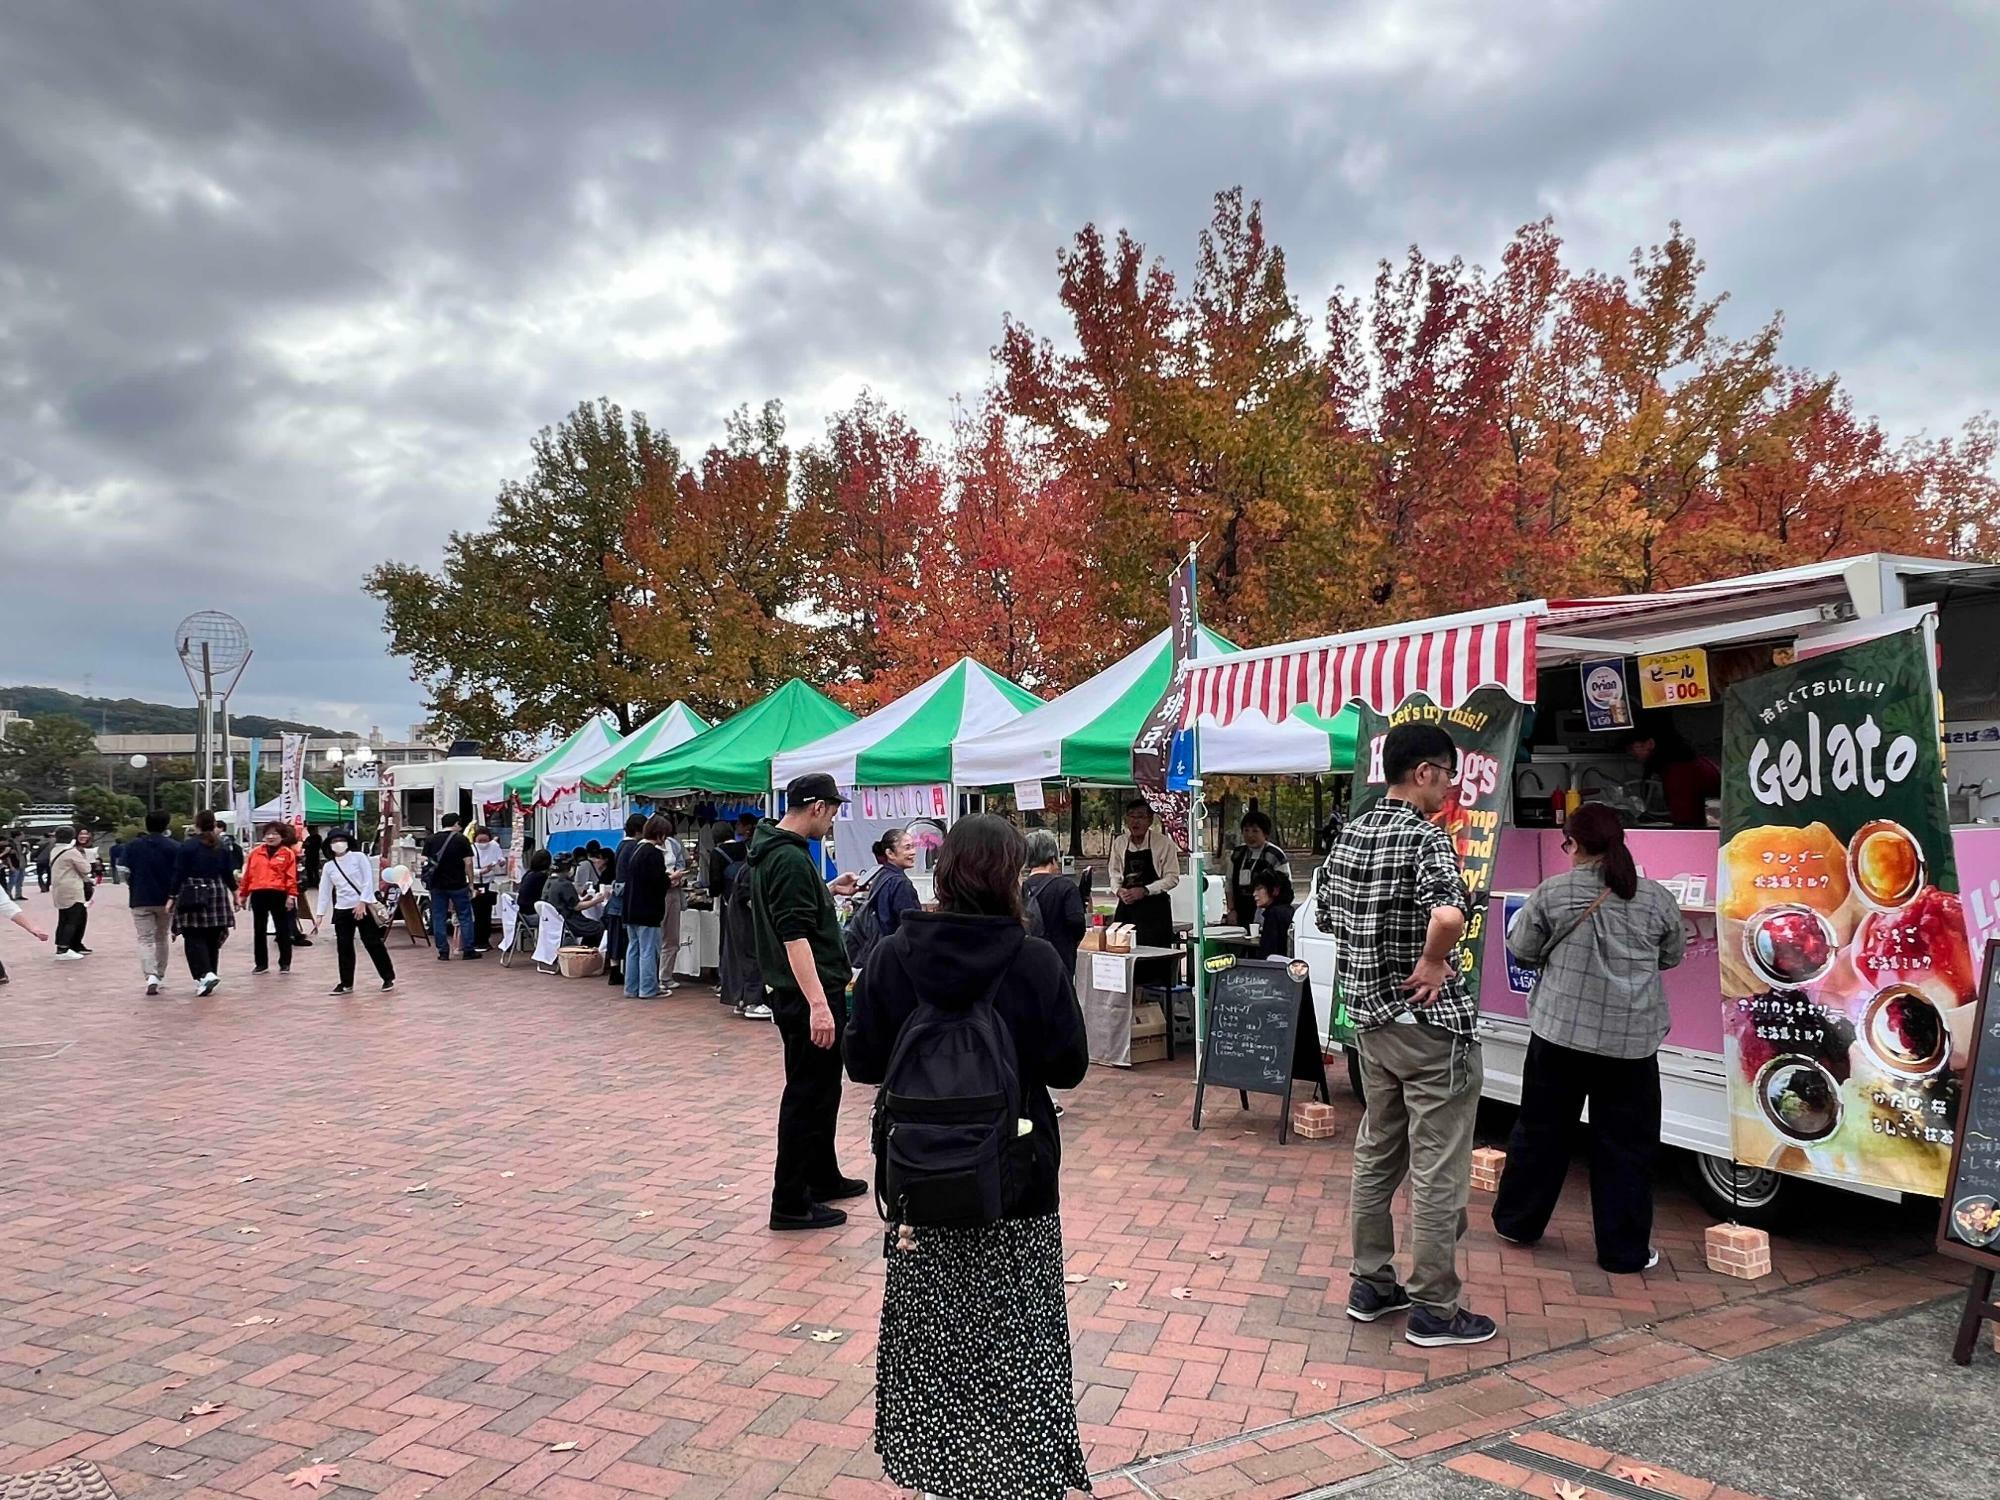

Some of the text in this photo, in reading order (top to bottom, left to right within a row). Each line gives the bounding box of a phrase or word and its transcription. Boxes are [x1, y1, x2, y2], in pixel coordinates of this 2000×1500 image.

[1651, 664, 1694, 682] ビール
[1591, 680, 1617, 691] Orion
[1387, 703, 1488, 732] Let's try this!!
[1748, 712, 1917, 806] Gelato
[1762, 850, 1825, 864] マンゴー
[1754, 874, 1830, 889] 北海道ミルク
[1867, 955, 1932, 970] 北海道ミルク
[1756, 1025, 1824, 1043] 北海道ミルク
